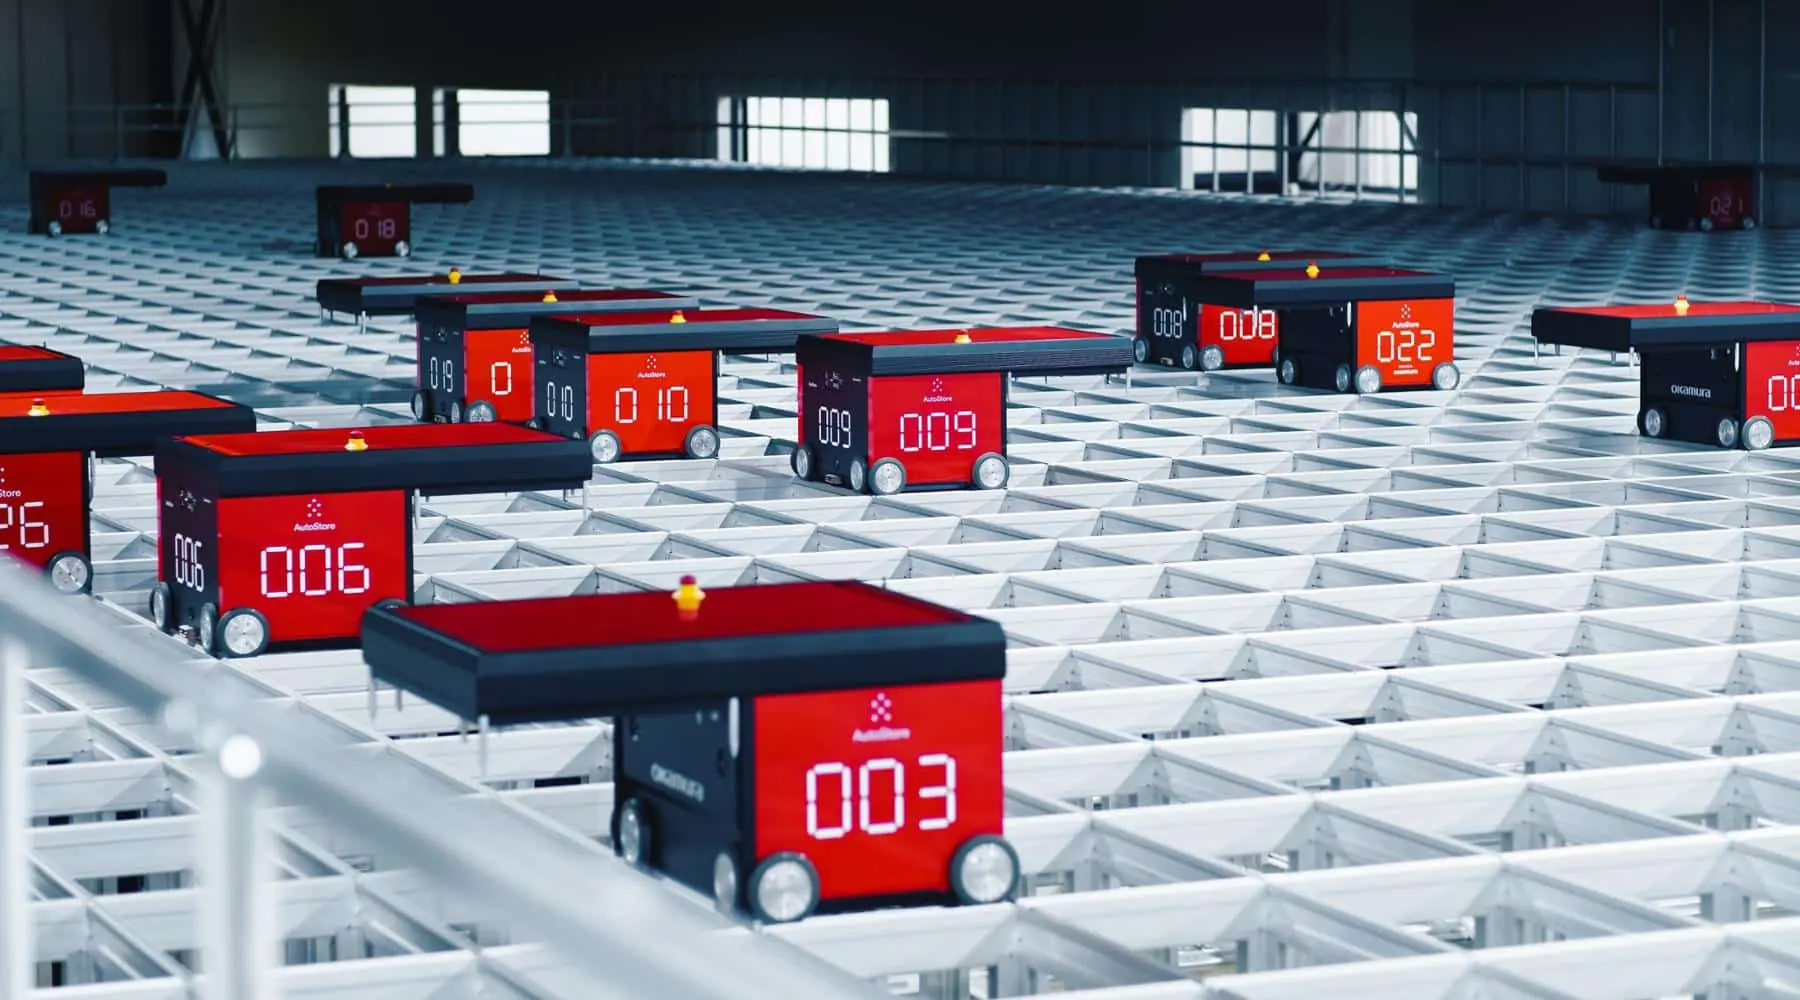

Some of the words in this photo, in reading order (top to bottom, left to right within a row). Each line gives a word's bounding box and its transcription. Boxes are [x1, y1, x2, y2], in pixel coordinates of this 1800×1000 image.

[60, 199, 97, 218] 016
[356, 218, 395, 239] 018
[1154, 308, 1183, 339] 008
[1220, 309, 1275, 341] 008
[1377, 330, 1435, 362] 022
[430, 356, 453, 393] 019
[547, 381, 573, 421] 010
[615, 386, 688, 423] 010
[818, 406, 851, 449] 009
[900, 410, 976, 451] 009
[294, 522, 336, 532] AutoStore
[175, 533, 204, 592] 006
[260, 542, 370, 598] 006
[852, 726, 911, 742] AutoStore
[806, 753, 956, 839] 003
